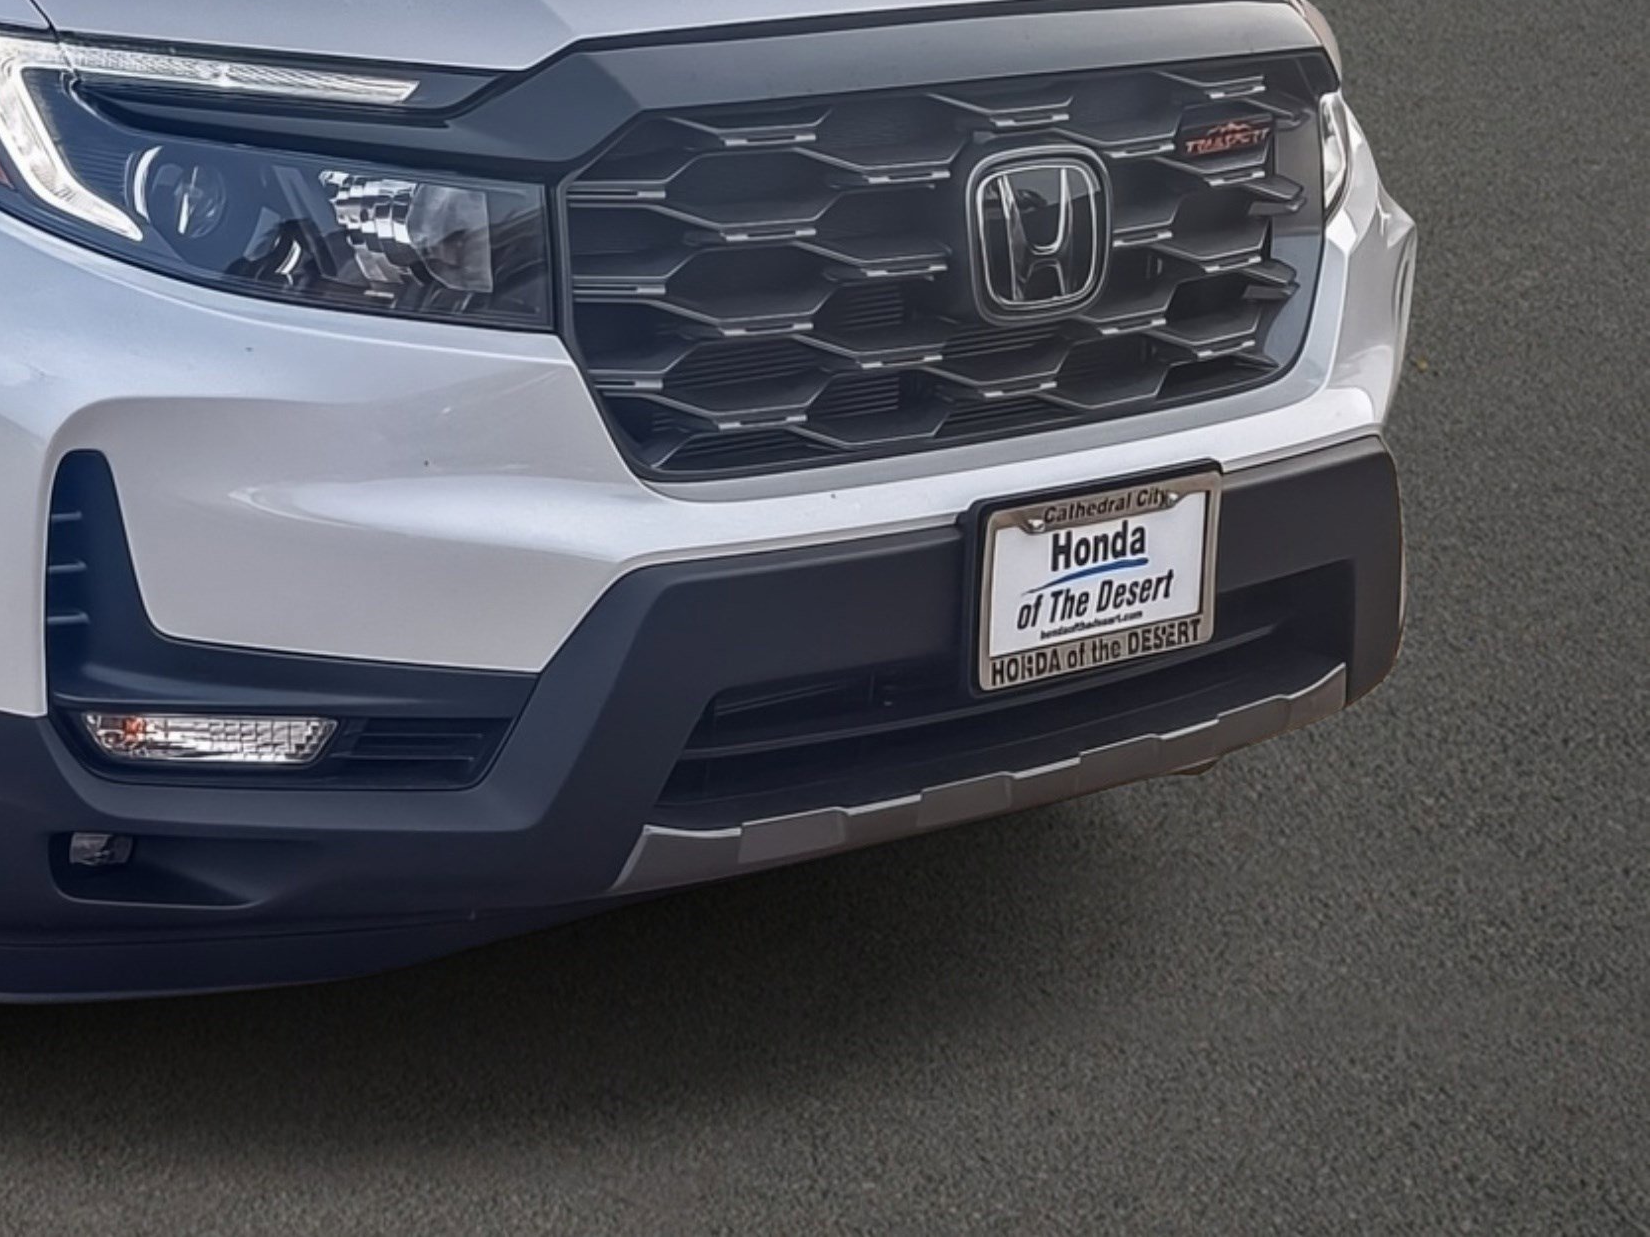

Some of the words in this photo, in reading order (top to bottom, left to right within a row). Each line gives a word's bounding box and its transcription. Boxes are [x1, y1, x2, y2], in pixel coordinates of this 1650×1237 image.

[1043, 495, 1136, 525] Cathedral
[1136, 488, 1169, 512] City
[1051, 520, 1146, 572] Honda
[1017, 595, 1043, 631] of
[1049, 588, 1091, 624] The
[1096, 569, 1175, 611] Desert
[991, 649, 1062, 687] HONDA
[1067, 643, 1089, 671] of
[1091, 638, 1121, 664] the
[1127, 618, 1201, 654] DESERT
